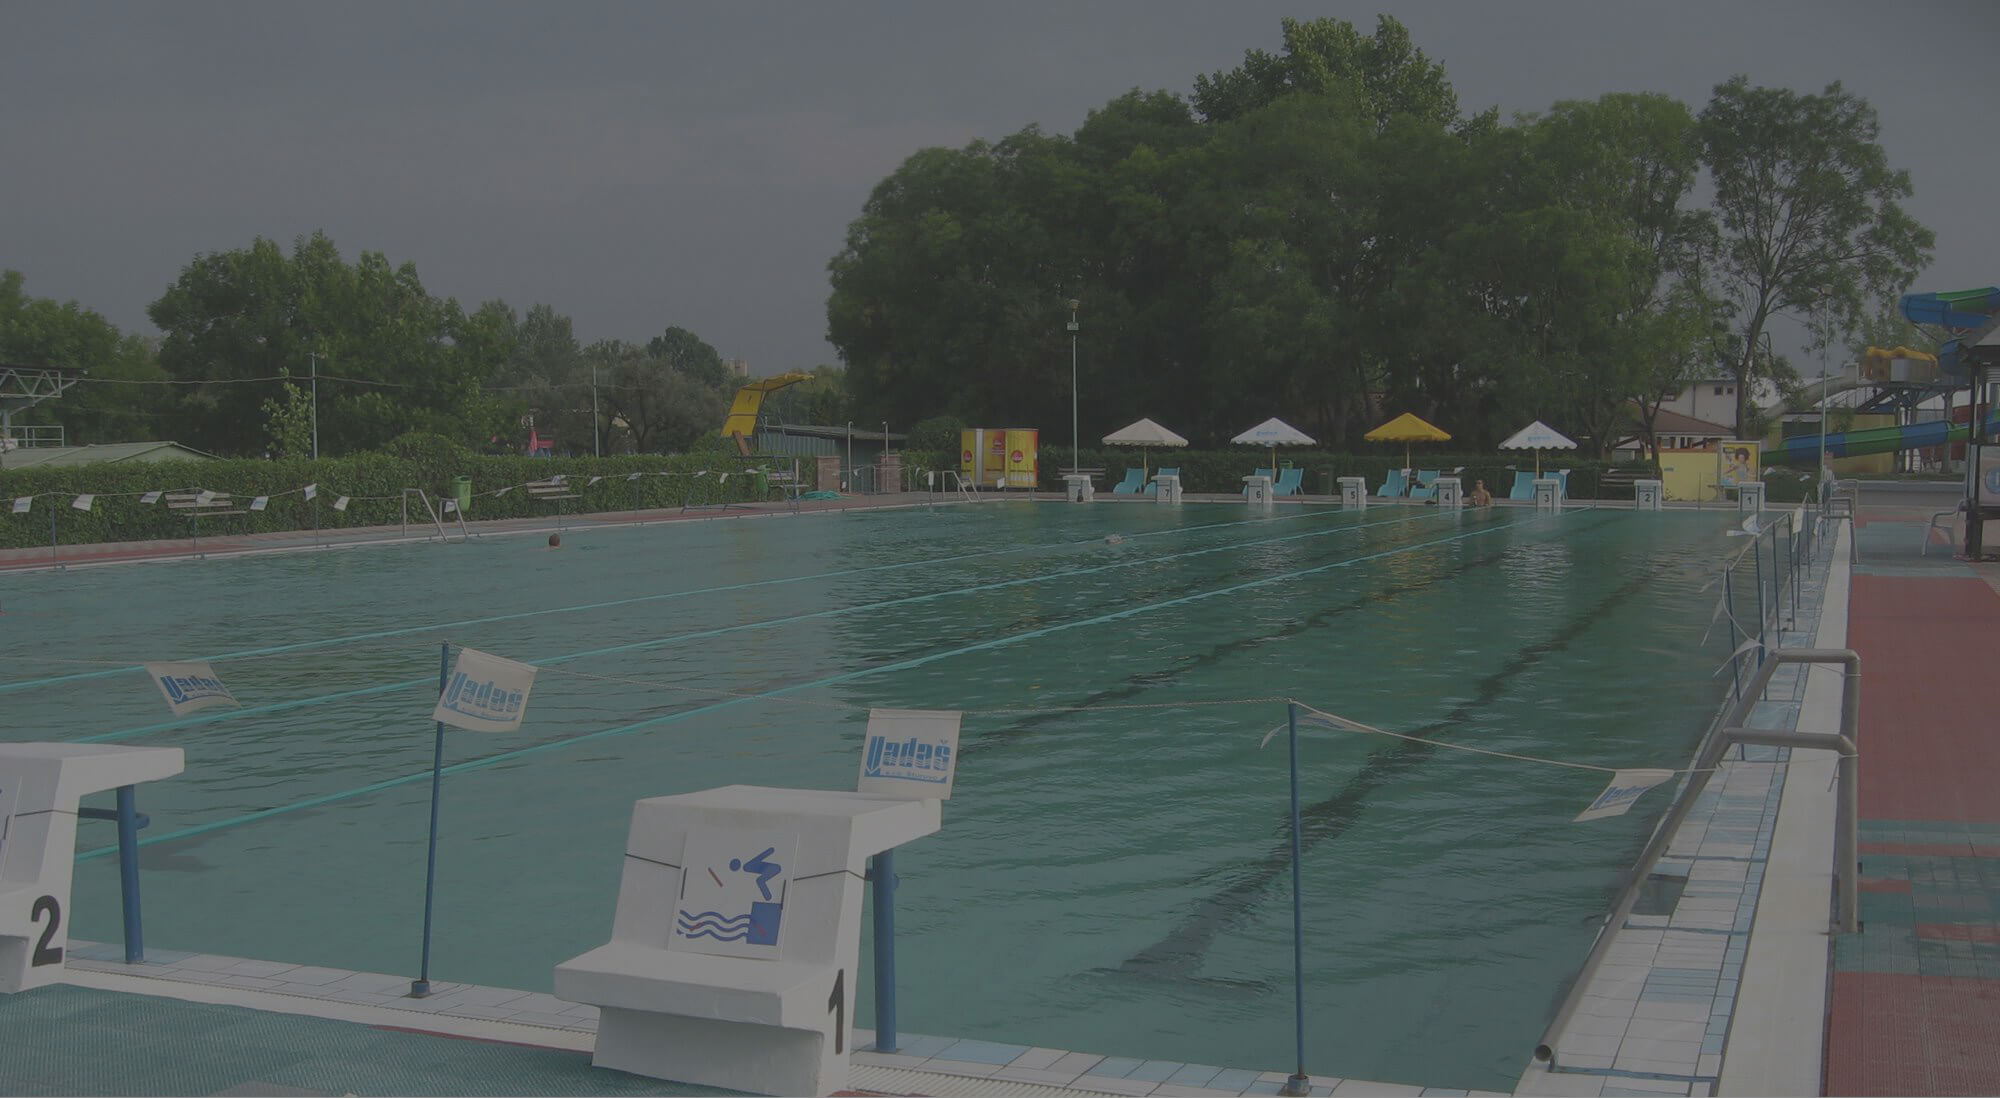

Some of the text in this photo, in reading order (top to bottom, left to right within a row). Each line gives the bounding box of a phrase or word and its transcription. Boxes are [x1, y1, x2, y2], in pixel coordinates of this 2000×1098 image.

[1256, 490, 1261, 499] 6
[1351, 491, 1356, 499] 5
[1645, 493, 1650, 502] 2
[31, 895, 63, 967] 2
[828, 968, 844, 1055] 1
